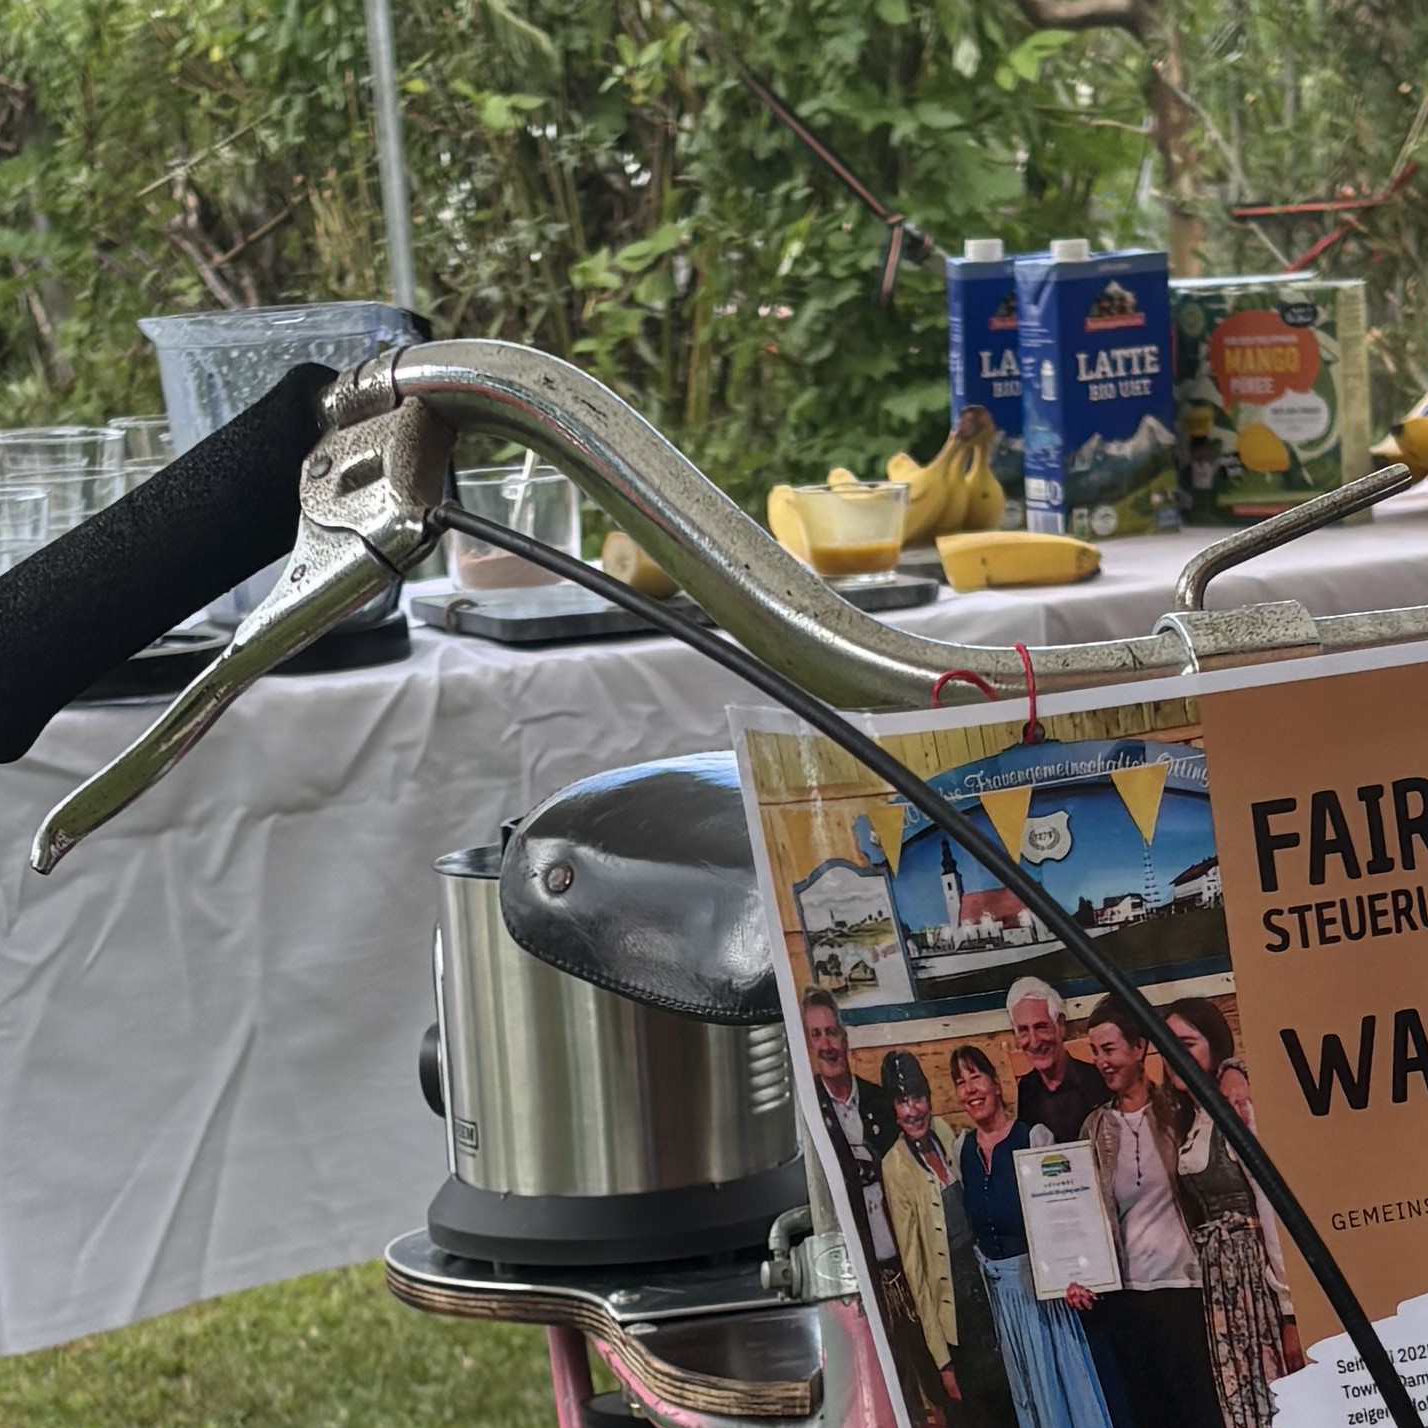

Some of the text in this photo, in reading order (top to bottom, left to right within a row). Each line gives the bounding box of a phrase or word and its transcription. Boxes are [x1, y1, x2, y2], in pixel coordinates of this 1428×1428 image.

[1076, 345, 1160, 381] LATTE
[1224, 346, 1301, 374] MANGO
[1088, 382, 1117, 401] BIO
